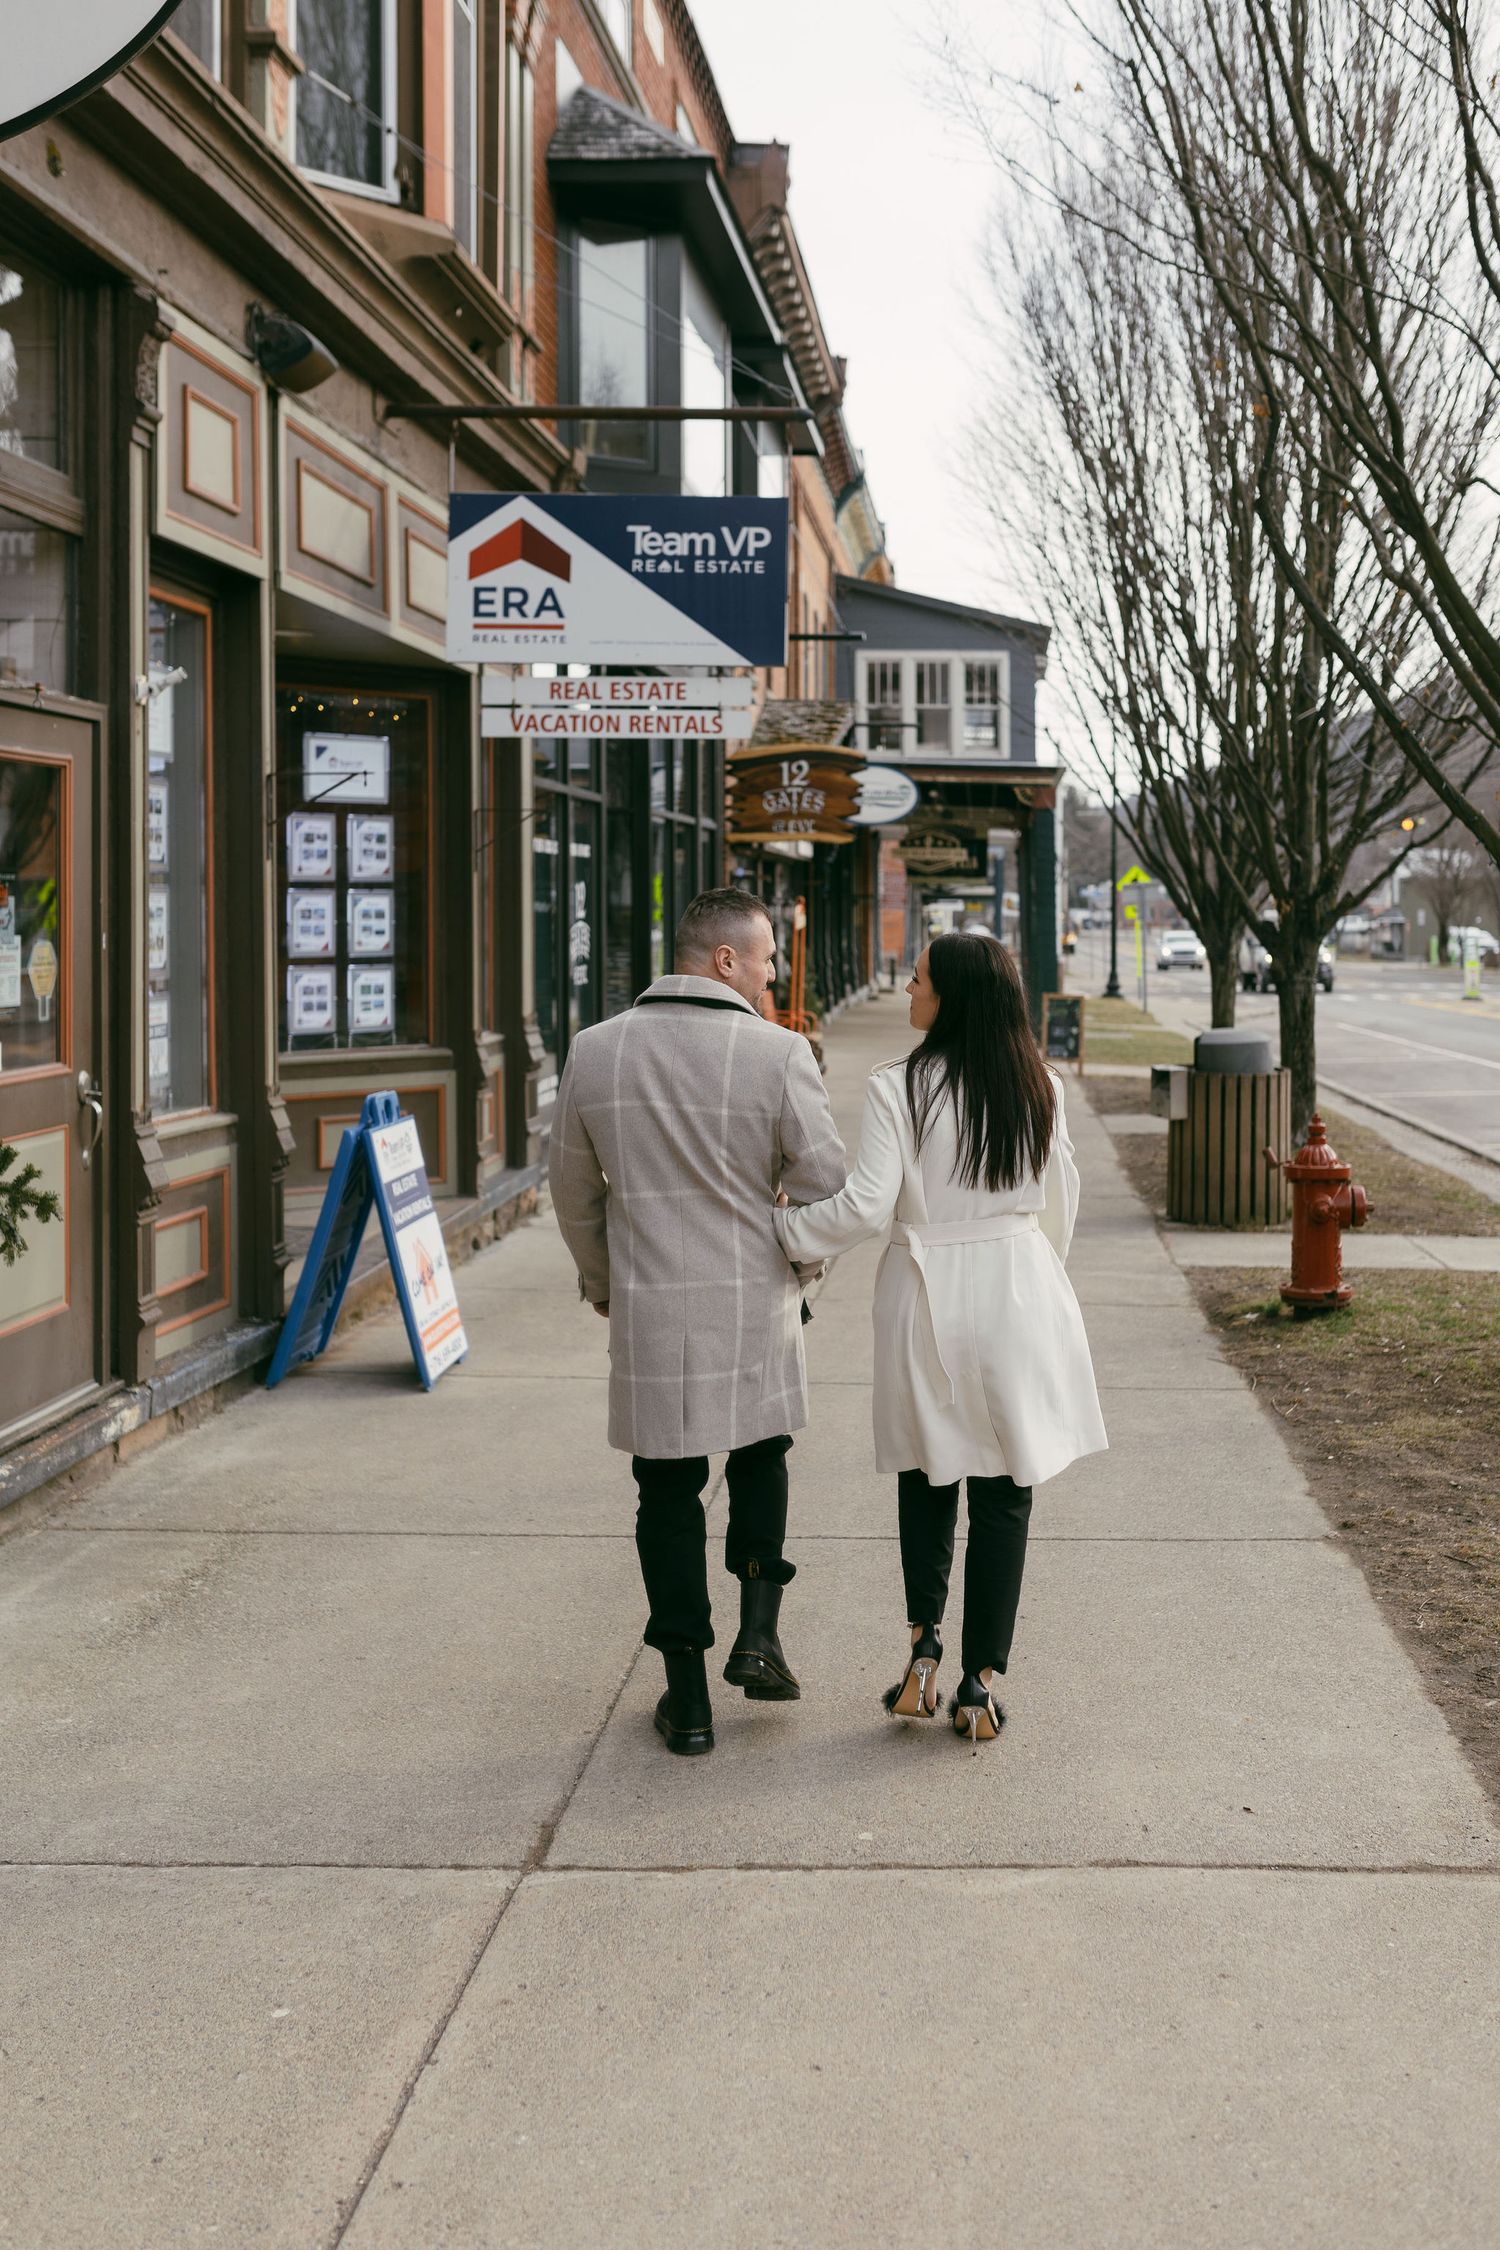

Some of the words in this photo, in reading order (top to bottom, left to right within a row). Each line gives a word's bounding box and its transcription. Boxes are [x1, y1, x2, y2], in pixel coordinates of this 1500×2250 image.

[626, 525, 716, 557] Team
[720, 526, 772, 557] VP
[631, 559, 685, 574] REAL
[694, 560, 766, 575] ESTATE
[473, 587, 565, 618] ERA
[472, 634, 507, 644] REAL
[514, 634, 567, 645] ESTATE
[549, 682, 602, 700] REAL
[610, 682, 687, 701] ESTATE
[511, 713, 620, 733] VACATION
[629, 714, 723, 734] RENTALS
[779, 760, 811, 787] 12
[762, 787, 826, 815] GATES
